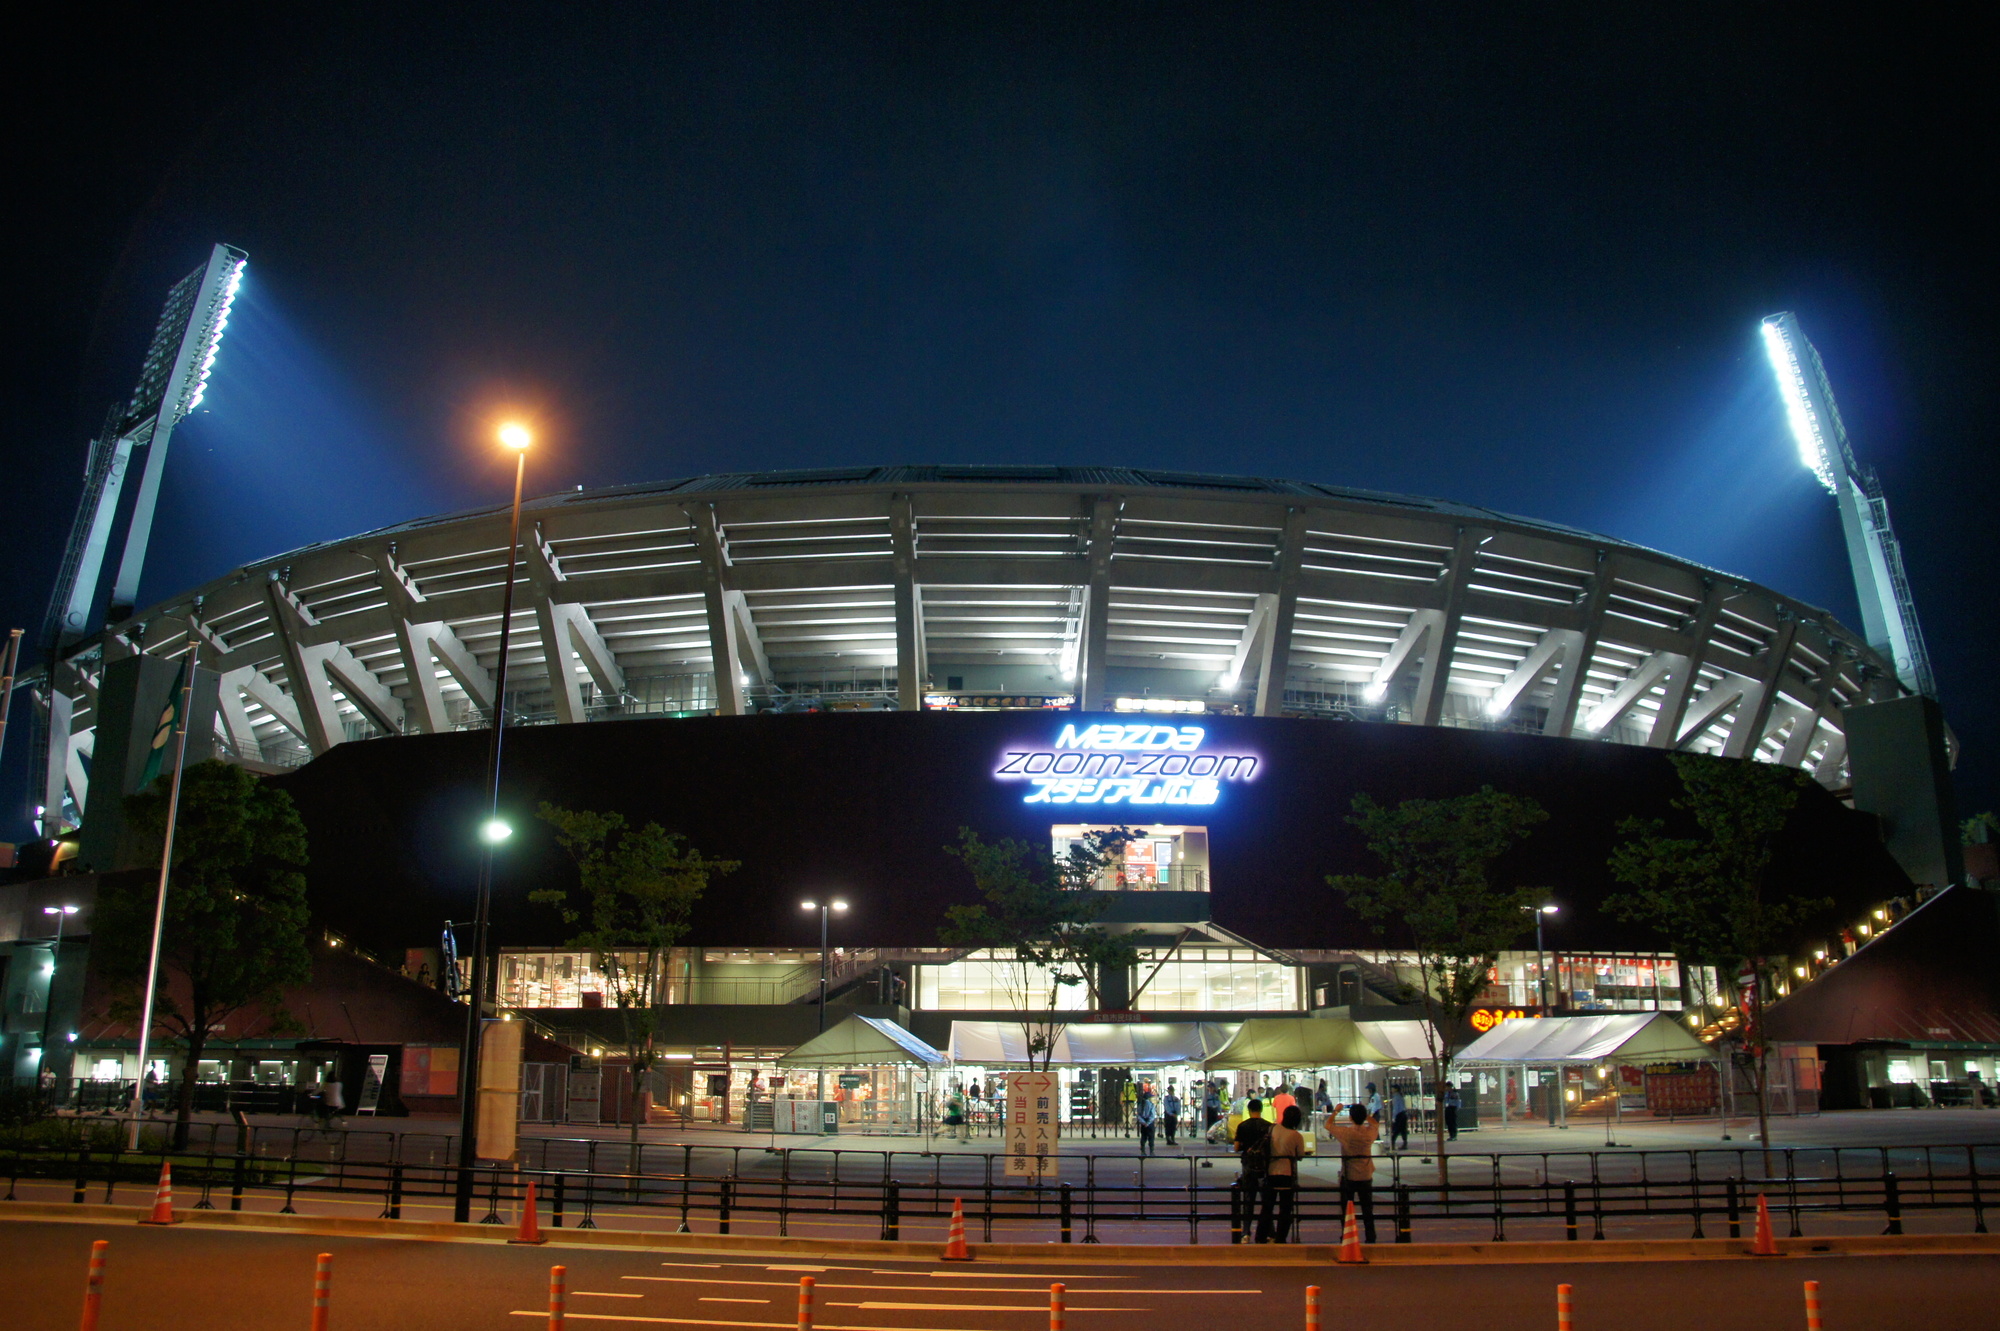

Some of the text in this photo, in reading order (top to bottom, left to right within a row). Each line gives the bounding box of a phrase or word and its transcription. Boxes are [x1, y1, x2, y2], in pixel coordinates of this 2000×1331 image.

[1023, 778, 1220, 805] スタジアム広島
[1014, 1096, 1026, 1171] 当日入場券
[1036, 1096, 1049, 1171] 前売入場券
